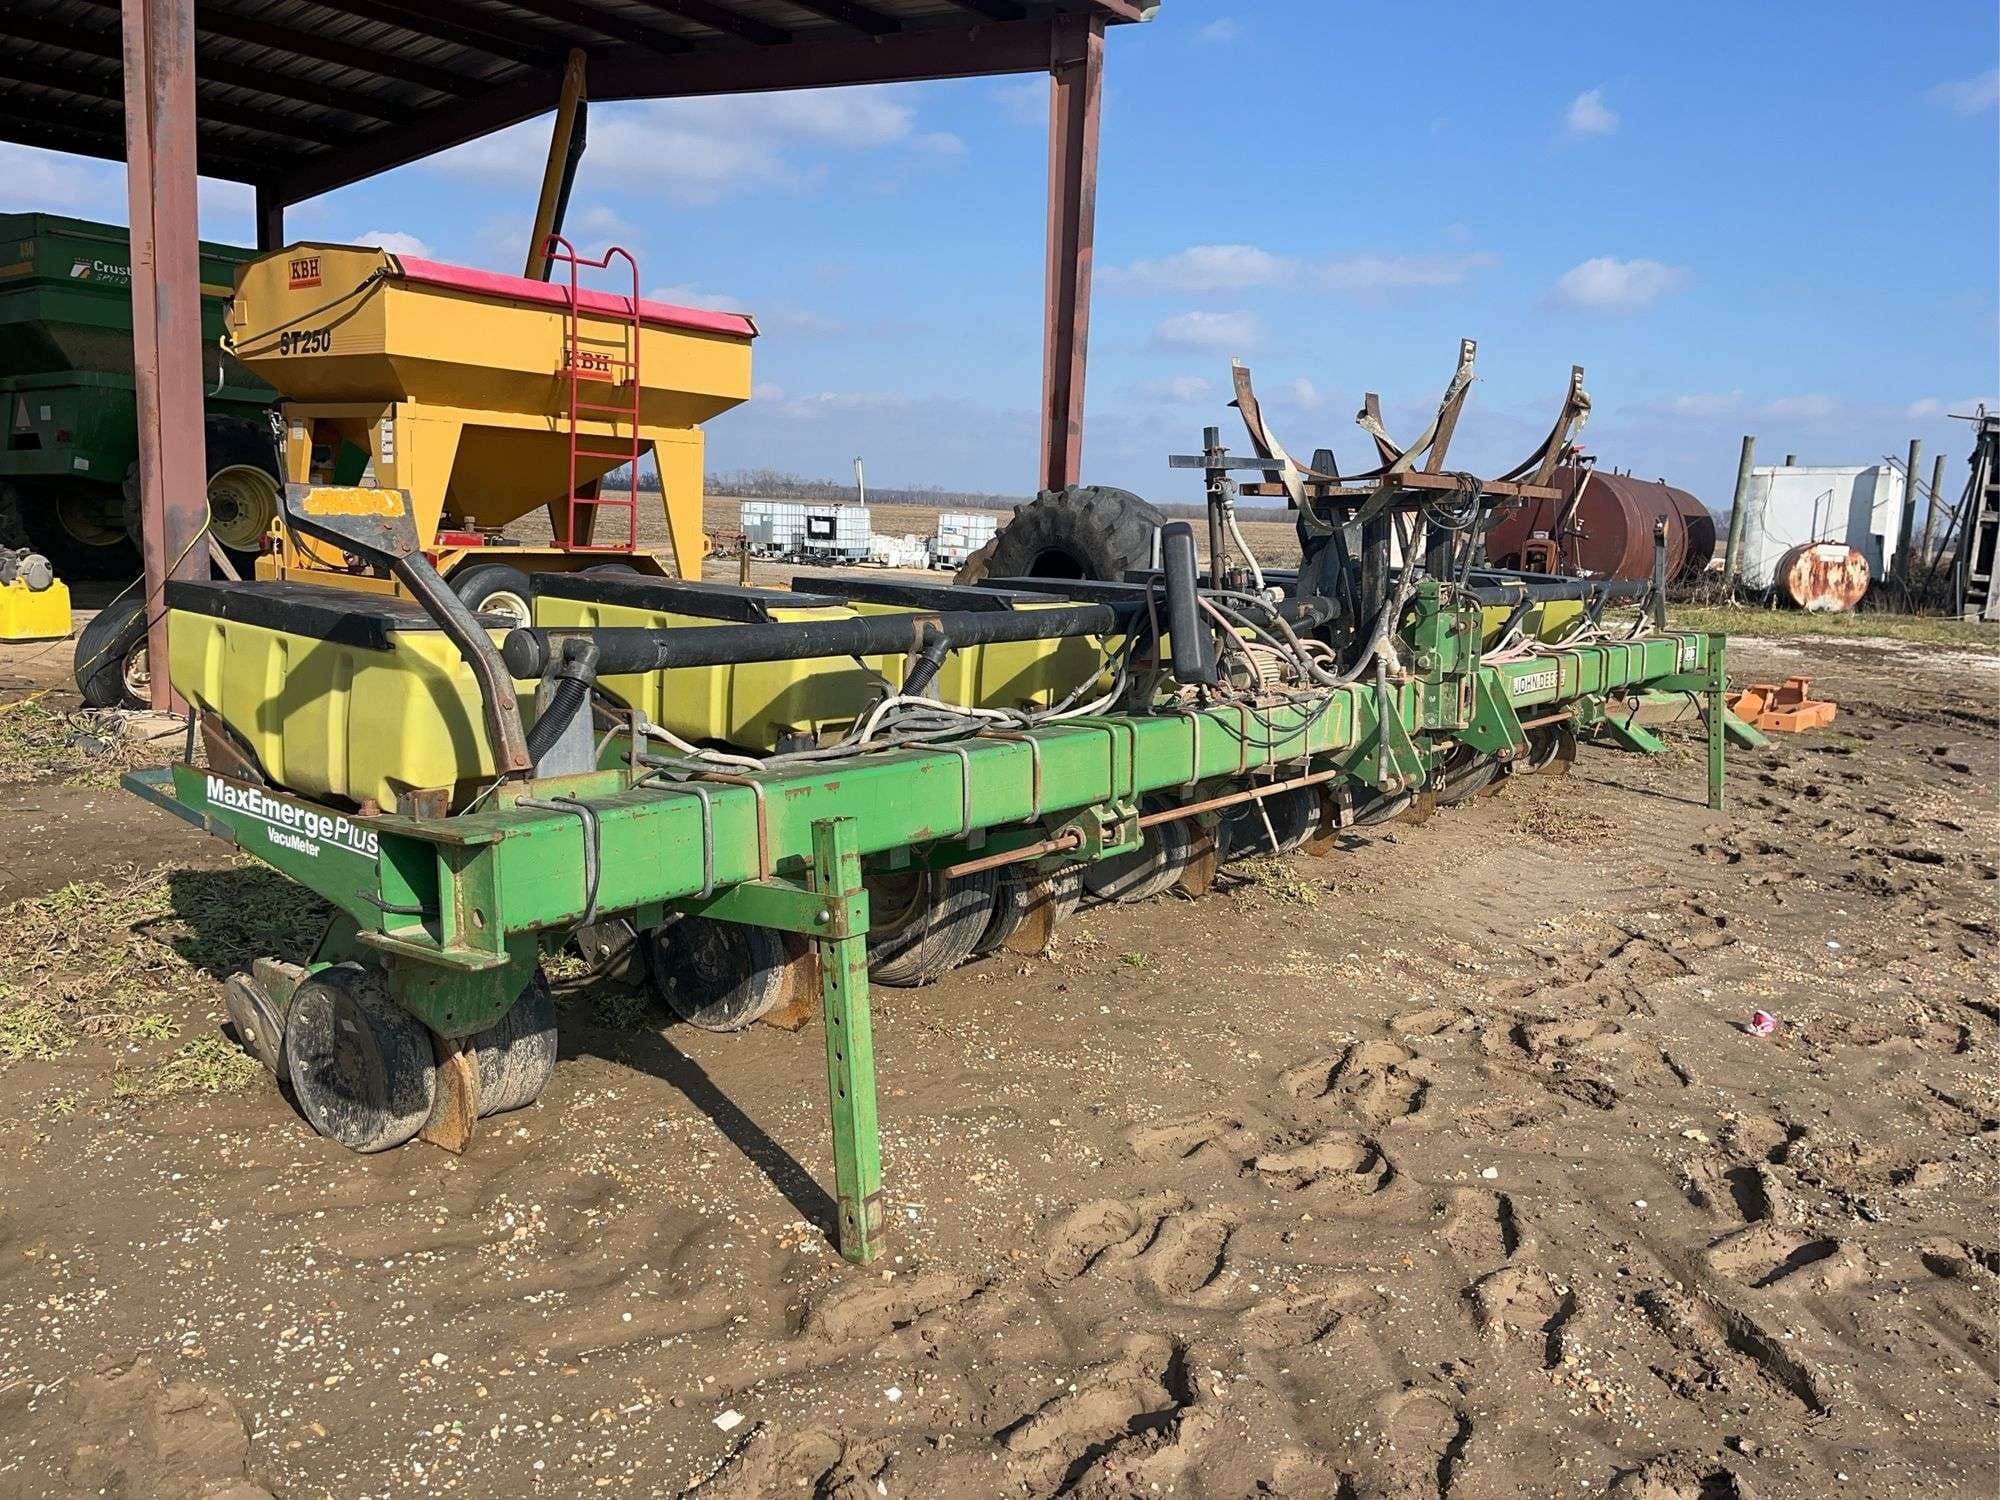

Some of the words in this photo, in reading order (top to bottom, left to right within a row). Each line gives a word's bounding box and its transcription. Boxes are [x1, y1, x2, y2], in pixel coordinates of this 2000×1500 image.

[291, 258, 320, 280] KBH
[280, 327, 331, 356] ST250
[563, 349, 609, 372] KBH
[1514, 674, 1537, 693] JOHN
[267, 825, 321, 858] VacuMeter
